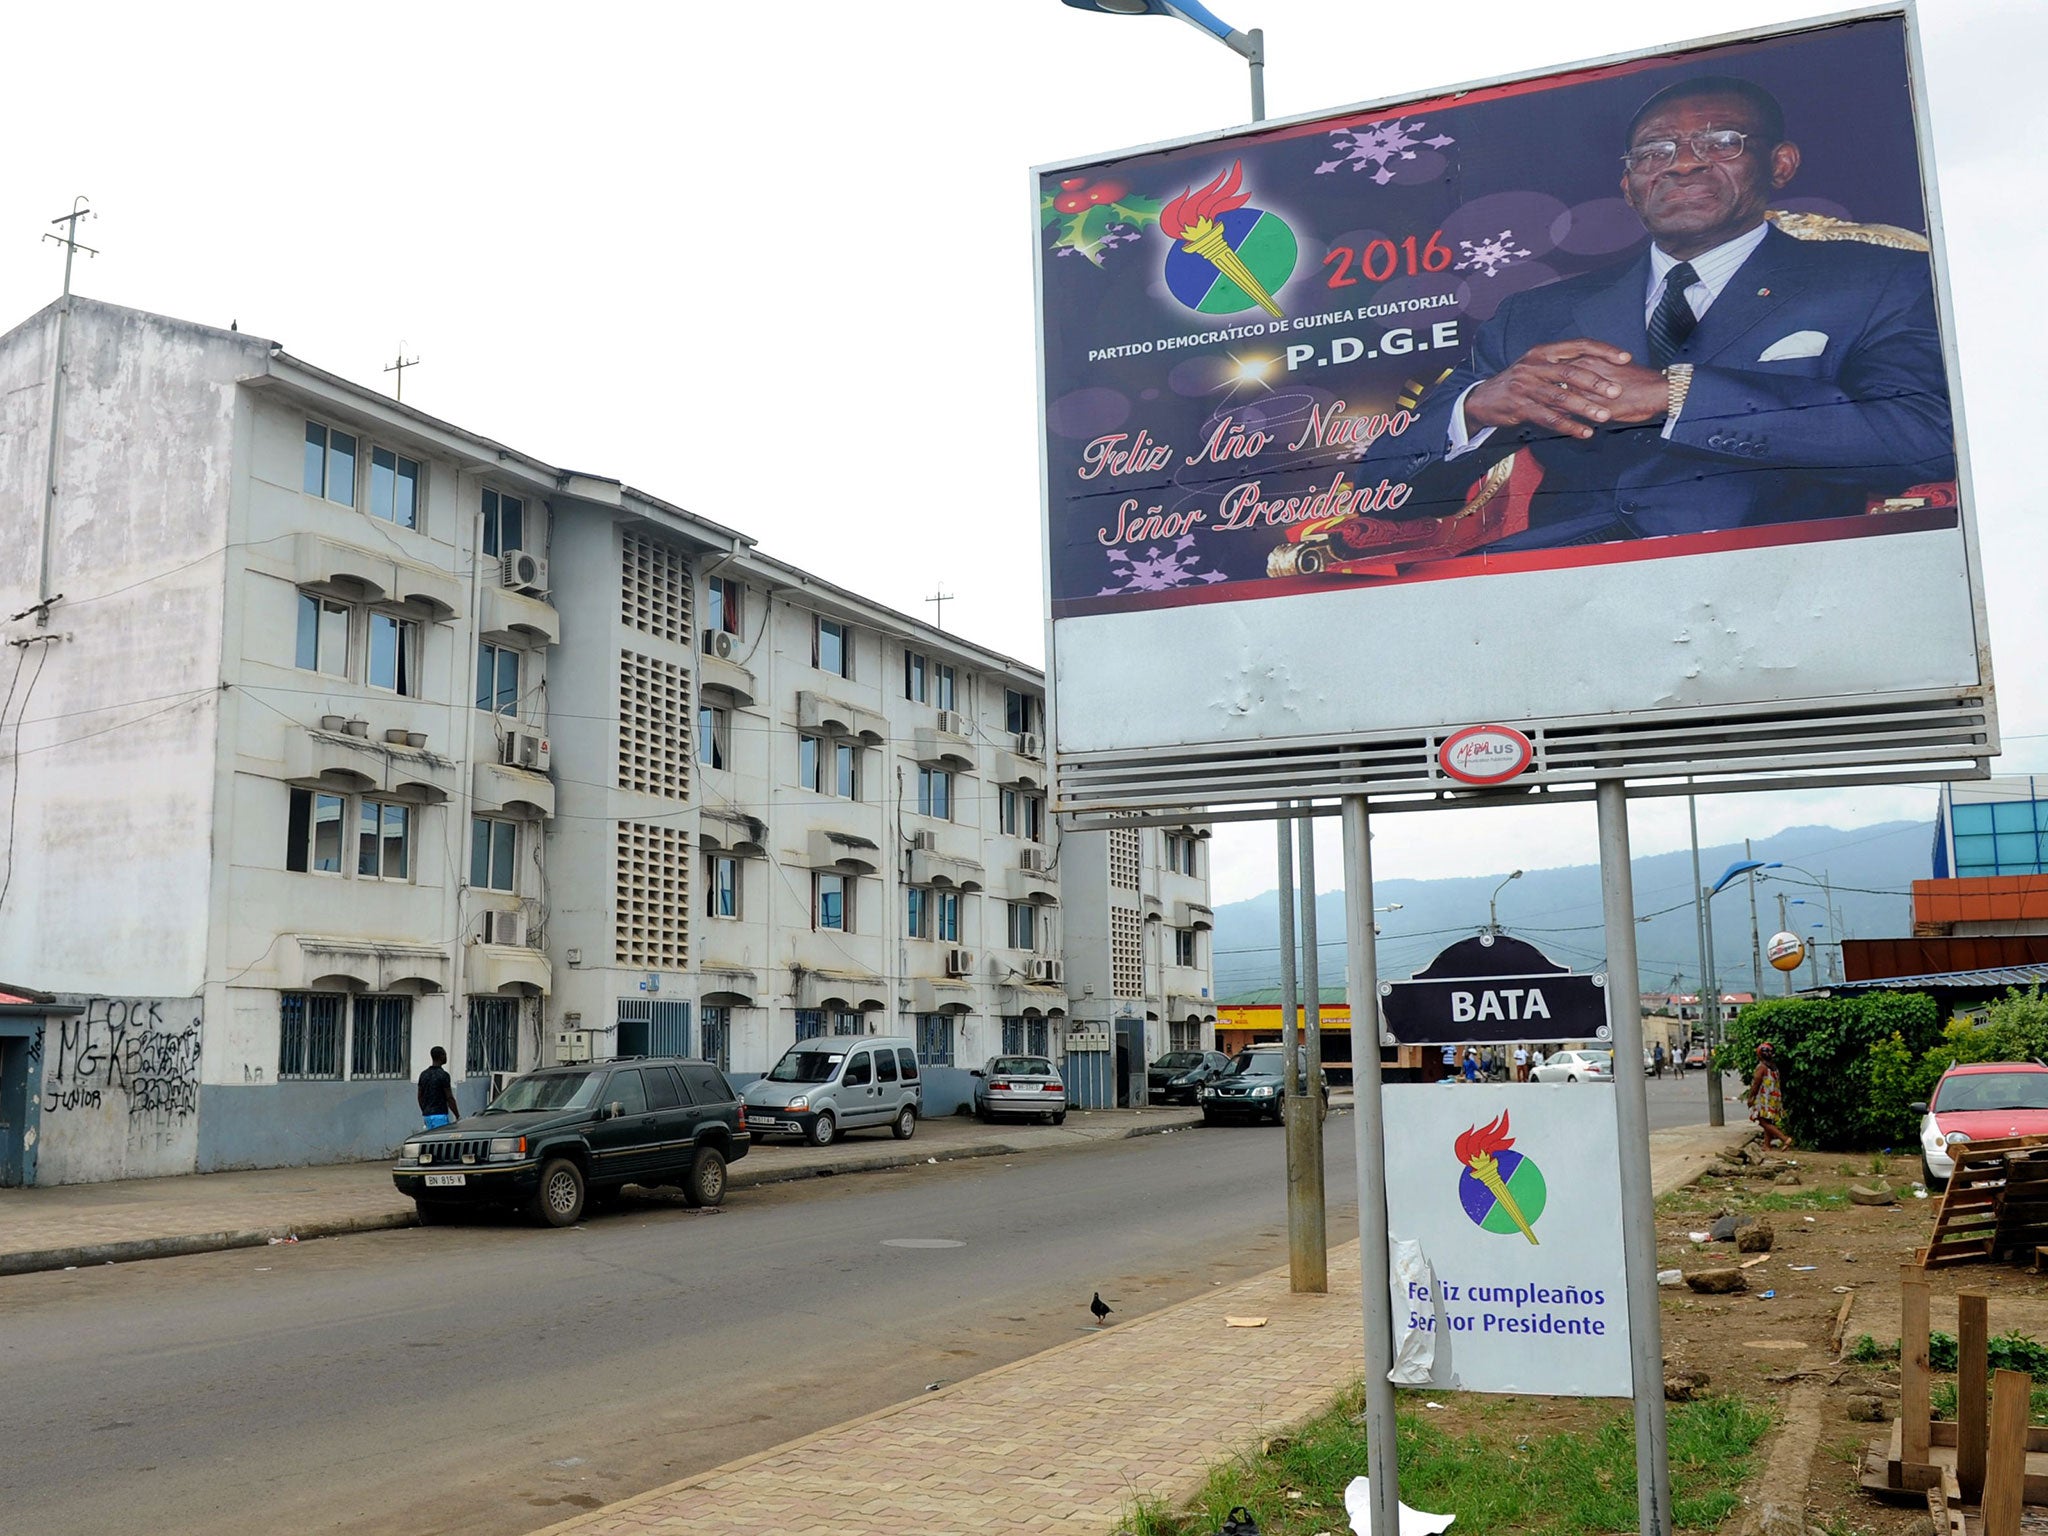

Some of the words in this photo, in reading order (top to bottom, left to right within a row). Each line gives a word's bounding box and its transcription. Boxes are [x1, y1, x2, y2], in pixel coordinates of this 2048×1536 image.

[1323, 230, 1452, 289] 2016
[1088, 341, 1153, 361] PARTIDO
[1156, 323, 1265, 351] DEMOCRÁTICO
[1269, 319, 1289, 334] DE
[1293, 310, 1354, 330] GUINEA
[1357, 293, 1459, 320] ECUATORIAL
[1286, 320, 1459, 371] P.D.G.E
[1078, 430, 1173, 480] Feliz
[1185, 416, 1275, 466] Año
[1288, 400, 1420, 451] Nuevo
[1098, 498, 1207, 546] Señor
[1211, 471, 1413, 531] Presidente
[1451, 988, 1551, 1023] BATA
[45, 1088, 102, 1112] JUNIOR
[440, 1176, 455, 1185] 815
[1468, 1283, 1605, 1308] cumpleaños
[1483, 1313, 1605, 1336] Presidente
